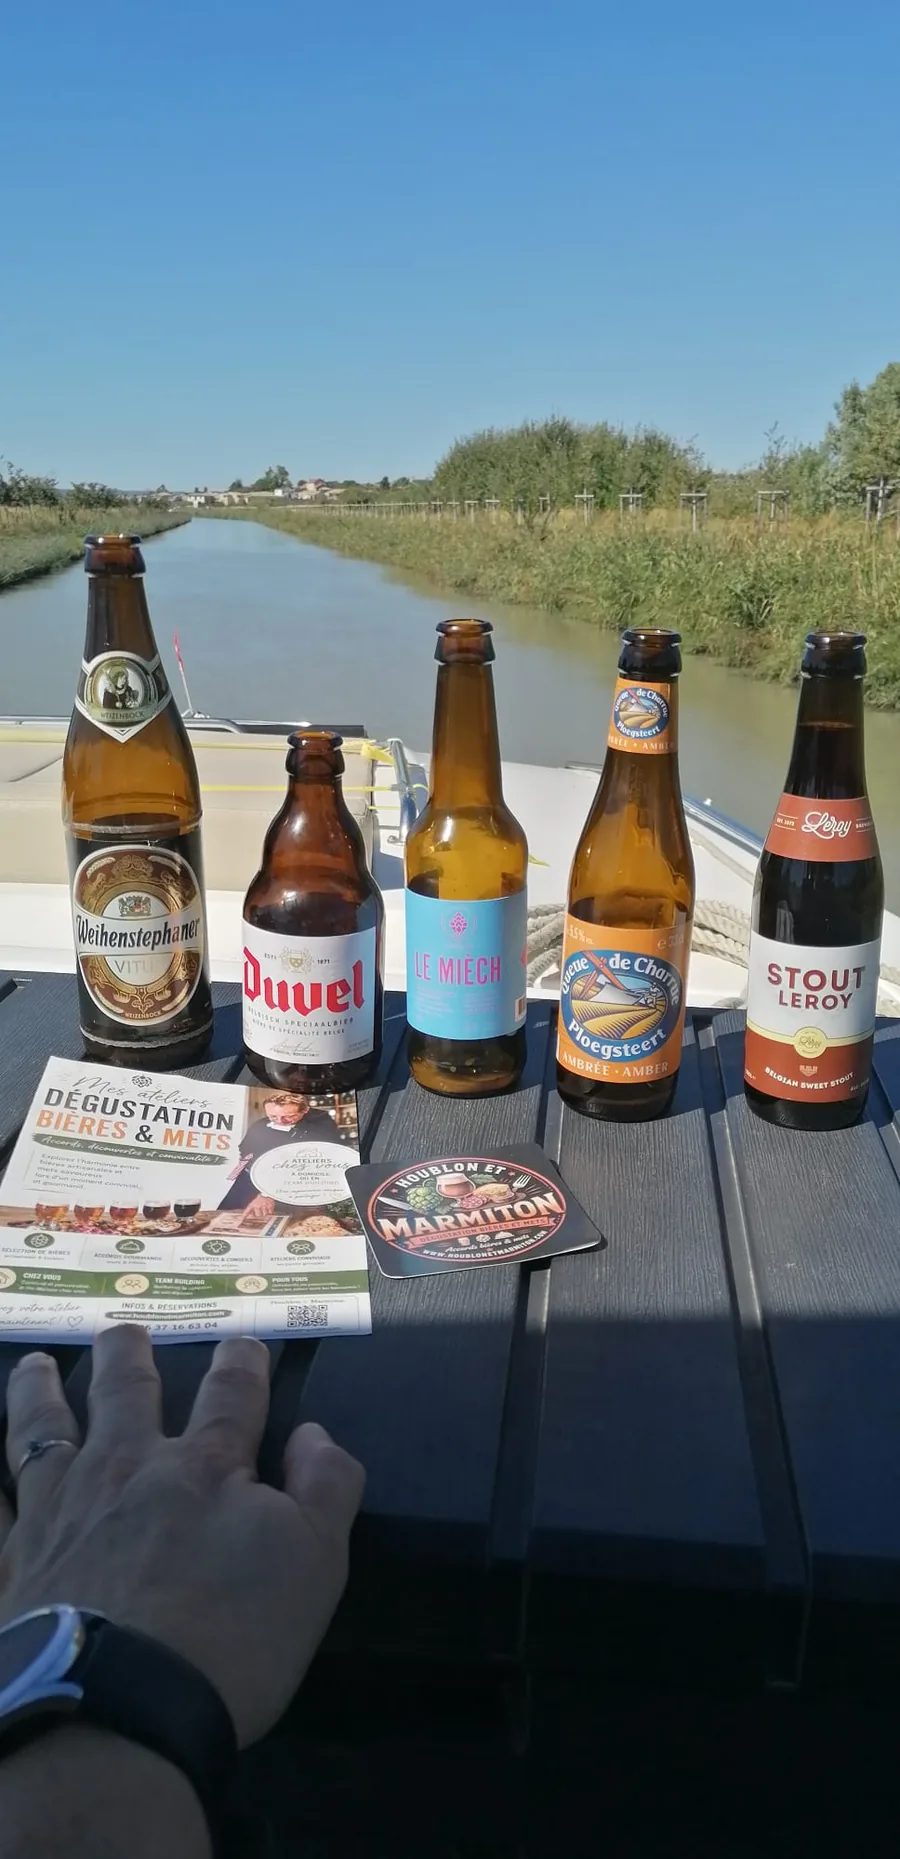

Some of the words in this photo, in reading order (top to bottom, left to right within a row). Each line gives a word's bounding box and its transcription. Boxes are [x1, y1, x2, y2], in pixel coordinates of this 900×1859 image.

[636, 688, 647, 697] de
[646, 690, 669, 718] Charrue
[100, 711, 145, 720] WEIZENBOCK
[616, 720, 660, 738] Ploegsteert
[801, 811, 852, 840] Leroy
[76, 914, 200, 951] Weihenstephaner
[415, 952, 431, 981] LE
[768, 962, 866, 992] STOUT
[243, 946, 365, 1016] Duvel
[562, 957, 590, 995] Queue
[608, 953, 631, 970] de
[634, 957, 680, 1006] Charrue
[778, 990, 853, 1010] LEROY
[124, 1010, 162, 1020] WEIZENBOCK
[248, 1006, 280, 1024] BELGISCH
[284, 1017, 354, 1028] SPECIAALBIER
[324, 1028, 345, 1036] BELGE
[568, 1018, 667, 1060] Ploegsteert
[562, 1051, 611, 1076] AMBRÉE
[622, 1061, 668, 1078] AMBER
[764, 1066, 799, 1088] BELGIAN
[800, 1082, 828, 1090] SWEET
[830, 1072, 855, 1088] STOUT
[72, 1075, 126, 1097] Mes
[137, 1088, 212, 1109] ateliers
[44, 1088, 234, 1132] DÉGUSTATION
[36, 1110, 128, 1140] BIÈRES
[134, 1124, 154, 1144] &
[162, 1128, 231, 1150] METS
[88, 1142, 142, 1157] découvertes
[146, 1150, 157, 1158] et
[60, 1170, 103, 1178] savoureux
[272, 1160, 311, 1172] chez
[316, 1162, 350, 1170] vous
[395, 1162, 480, 1189] HOUBLON
[484, 1164, 508, 1176] ET
[70, 1177, 103, 1186] moment
[377, 1192, 565, 1242] MARMITON
[510, 1220, 522, 1228] ET
[524, 1218, 546, 1226] METS
[422, 1230, 549, 1259] WWW.HOUBLONETMARMITON.COM
[445, 1244, 478, 1253] Accords
[514, 1234, 530, 1242] mets
[22, 1272, 42, 1280] CHEZ
[122, 1302, 146, 1310] INFOS
[158, 1302, 218, 1310] RÉSERVATIONS
[188, 1322, 201, 1330] 63
